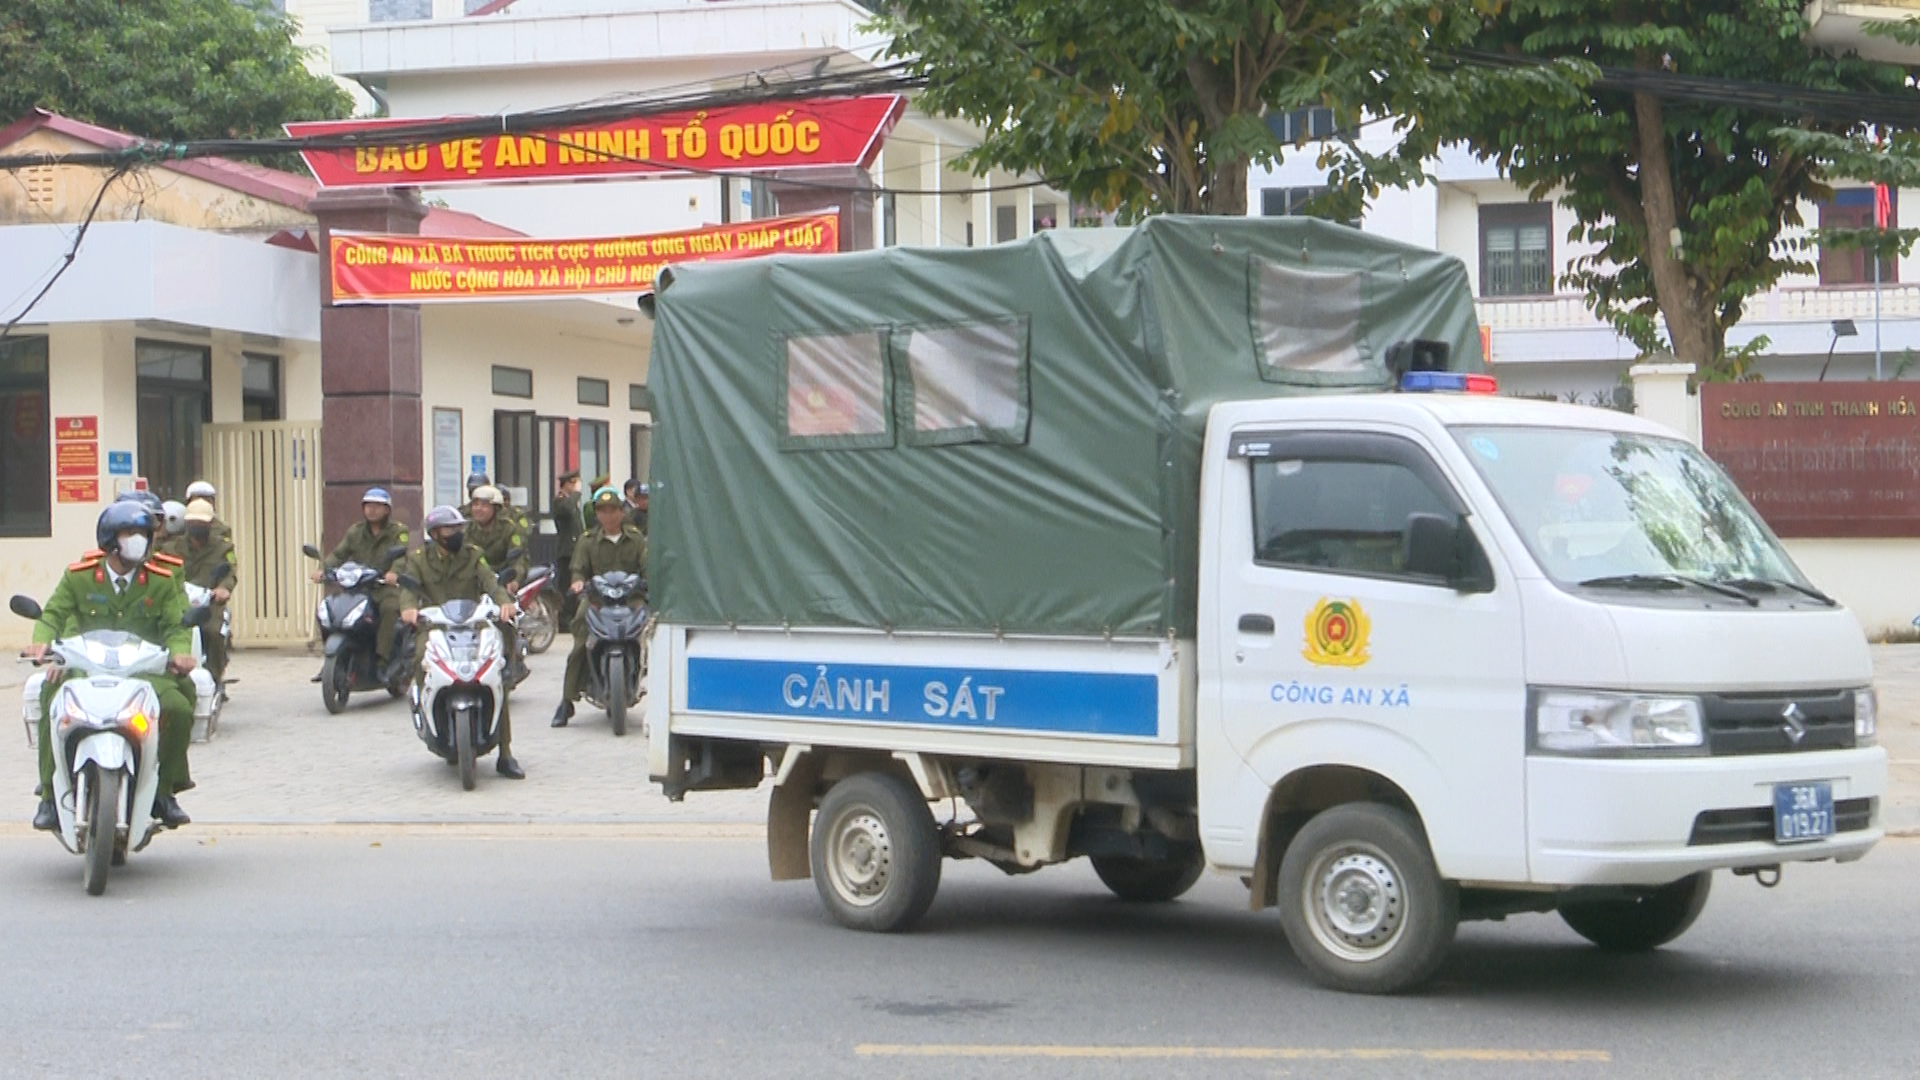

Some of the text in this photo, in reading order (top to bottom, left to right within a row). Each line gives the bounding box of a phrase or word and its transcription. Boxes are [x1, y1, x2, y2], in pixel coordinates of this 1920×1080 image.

[495, 134, 546, 167] AN
[559, 129, 650, 164] NINH
[662, 110, 708, 159] TỔ
[719, 108, 820, 161] QUỐC
[345, 243, 388, 265] CÔNG
[391, 246, 414, 264] AN
[418, 242, 439, 264] XÃ
[443, 243, 464, 264] BÁ
[738, 226, 780, 250] PHÁP
[784, 223, 823, 250] LUẬT
[410, 266, 452, 290] NƯỚC
[456, 266, 499, 293] CỘNG
[503, 265, 535, 288] HÒA
[538, 265, 560, 287] XÃ
[564, 264, 591, 289] HỘI
[595, 260, 627, 285] CHỦ
[1767, 401, 1788, 416] AN
[1831, 401, 1880, 416] THANH
[782, 665, 1005, 720] CẢNH SÁT
[1270, 680, 1411, 706] CÔNG AN XÃ
